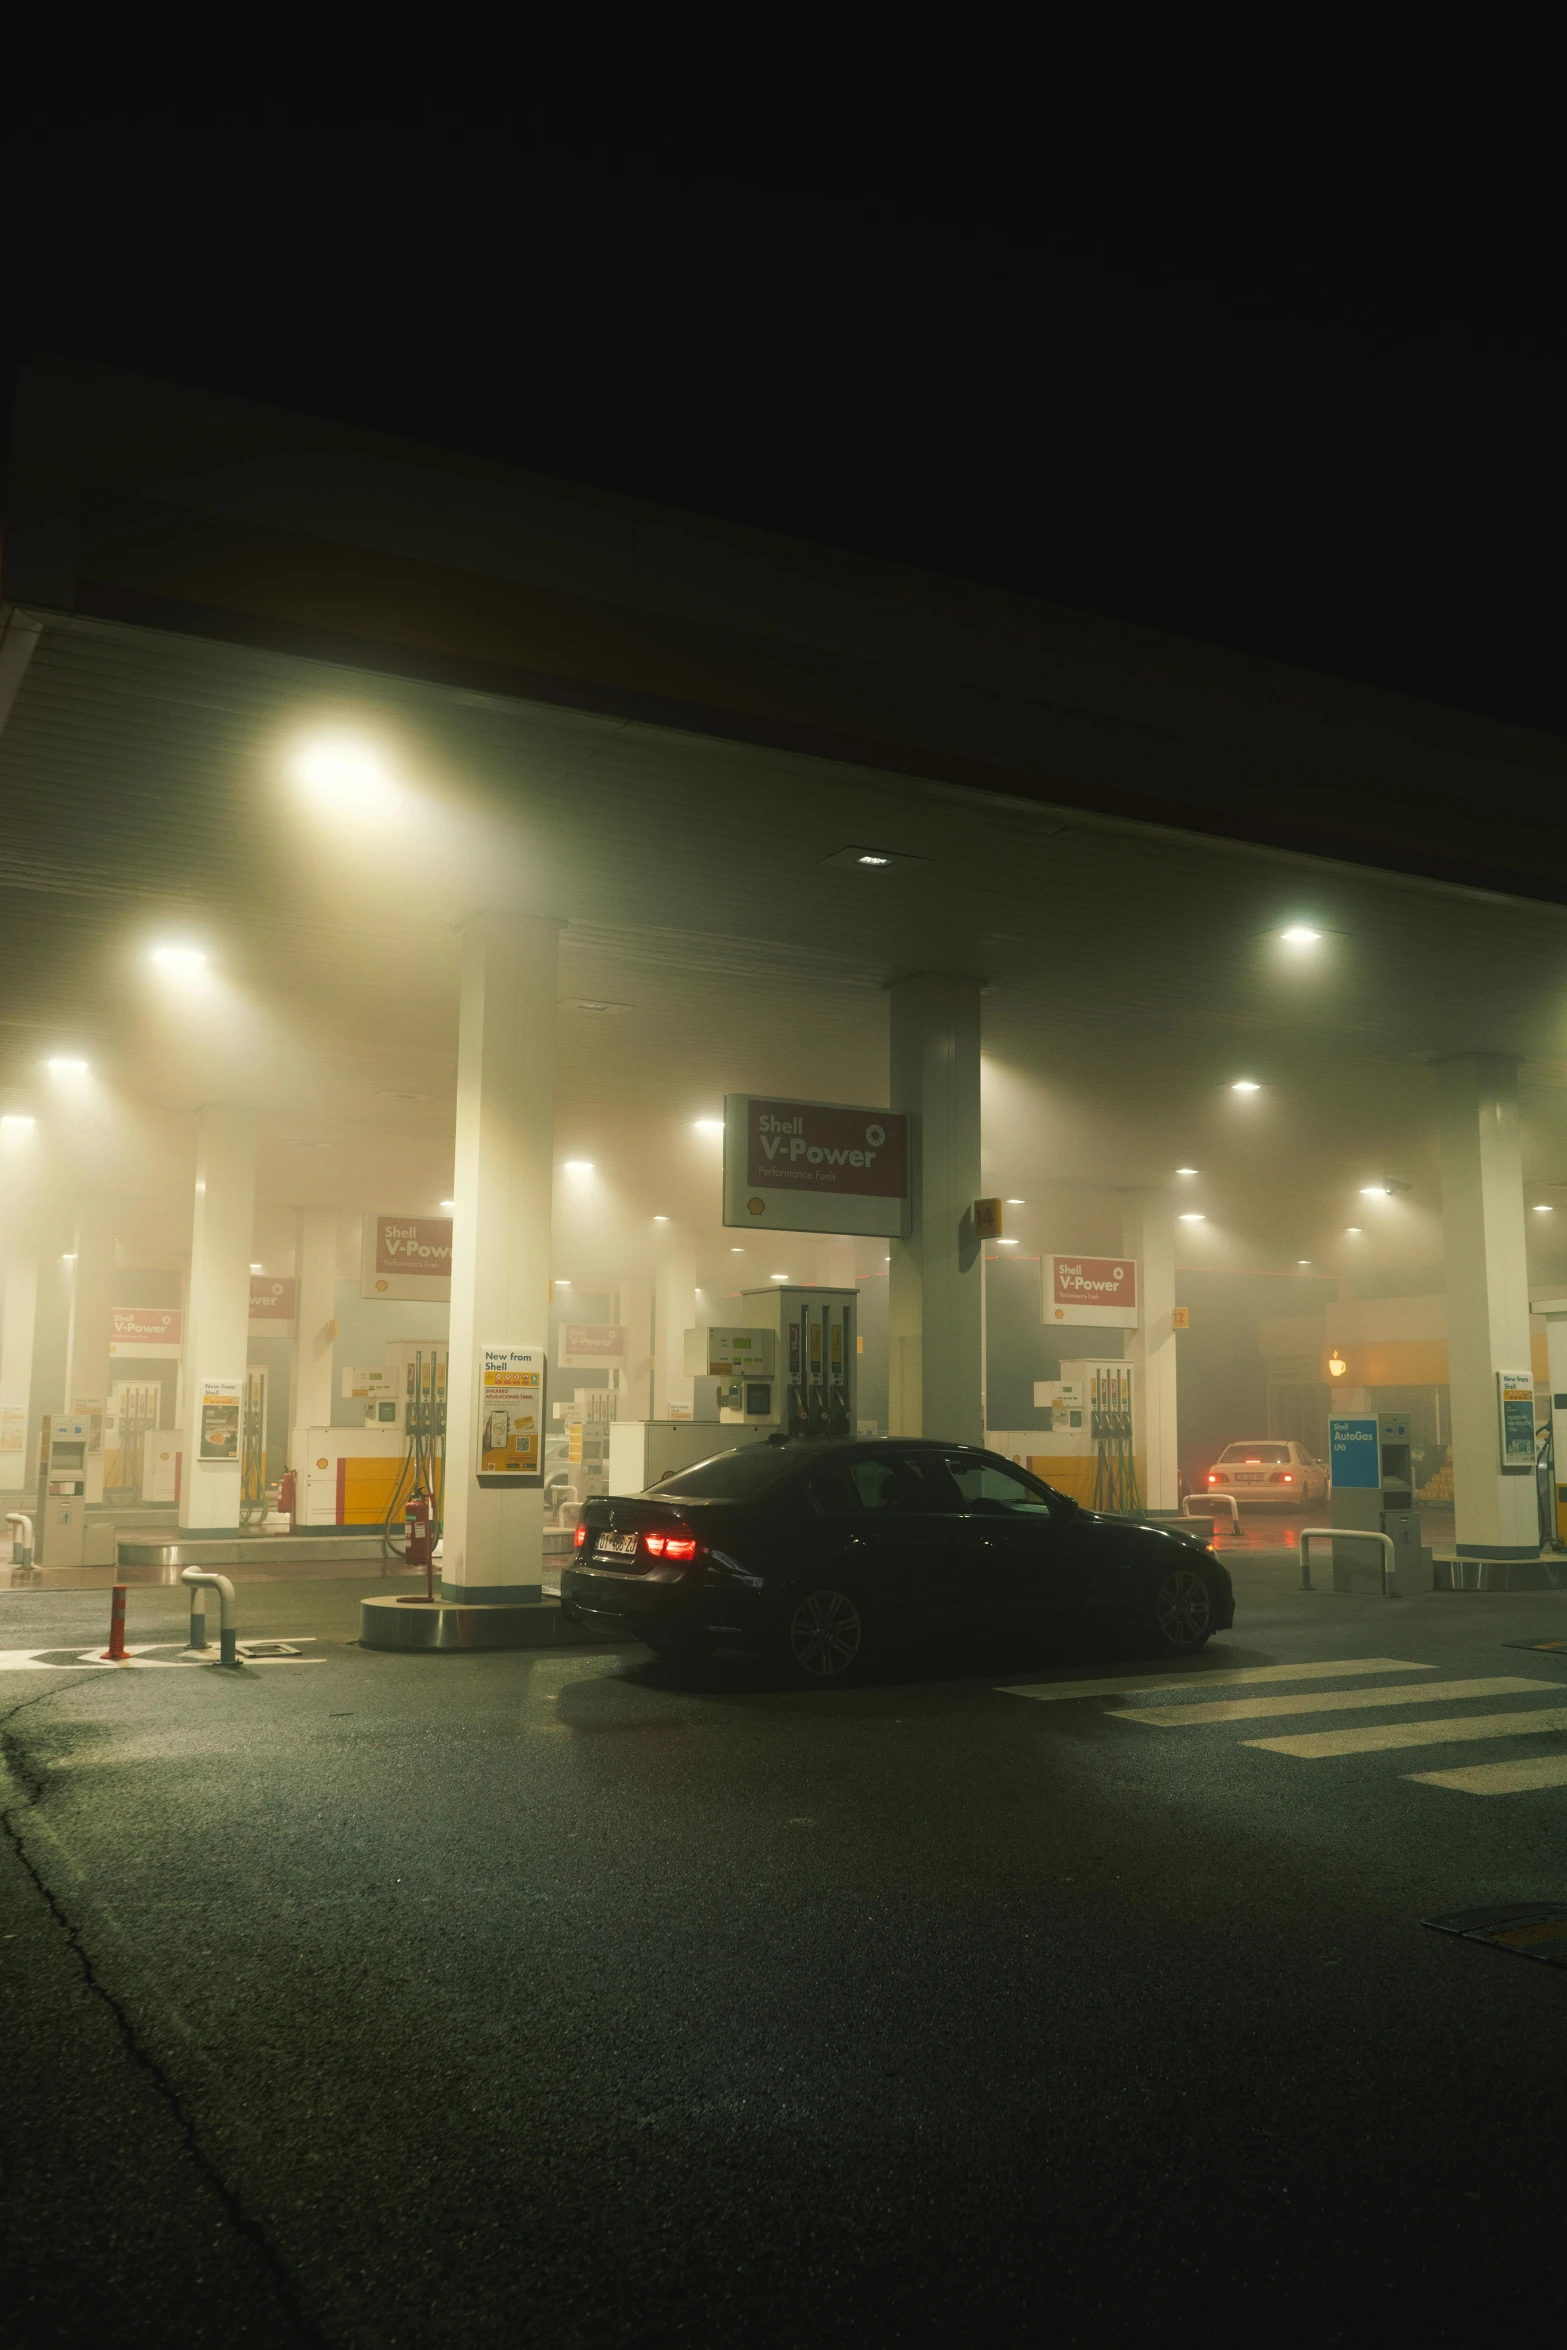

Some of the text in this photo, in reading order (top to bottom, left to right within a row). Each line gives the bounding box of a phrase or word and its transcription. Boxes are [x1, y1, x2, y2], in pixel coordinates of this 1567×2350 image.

[759, 1114, 803, 1135] Shell
[759, 1135, 877, 1168] V-Power
[758, 1165, 836, 1182] Performance Fuels
[975, 1207, 994, 1228] 14
[384, 1225, 417, 1239] Shell
[385, 1238, 453, 1258] V-Pow
[1059, 1264, 1082, 1275] Shell
[1059, 1275, 1119, 1292] V-Power
[1173, 1312, 1184, 1323] 12
[114, 1322, 167, 1333] V-Power
[570, 1336, 613, 1346] V-Power
[485, 1351, 532, 1361] New from
[485, 1362, 507, 1371] Shell
[1333, 1423, 1349, 1431] Shell
[1334, 1431, 1373, 1441] AutoGas
